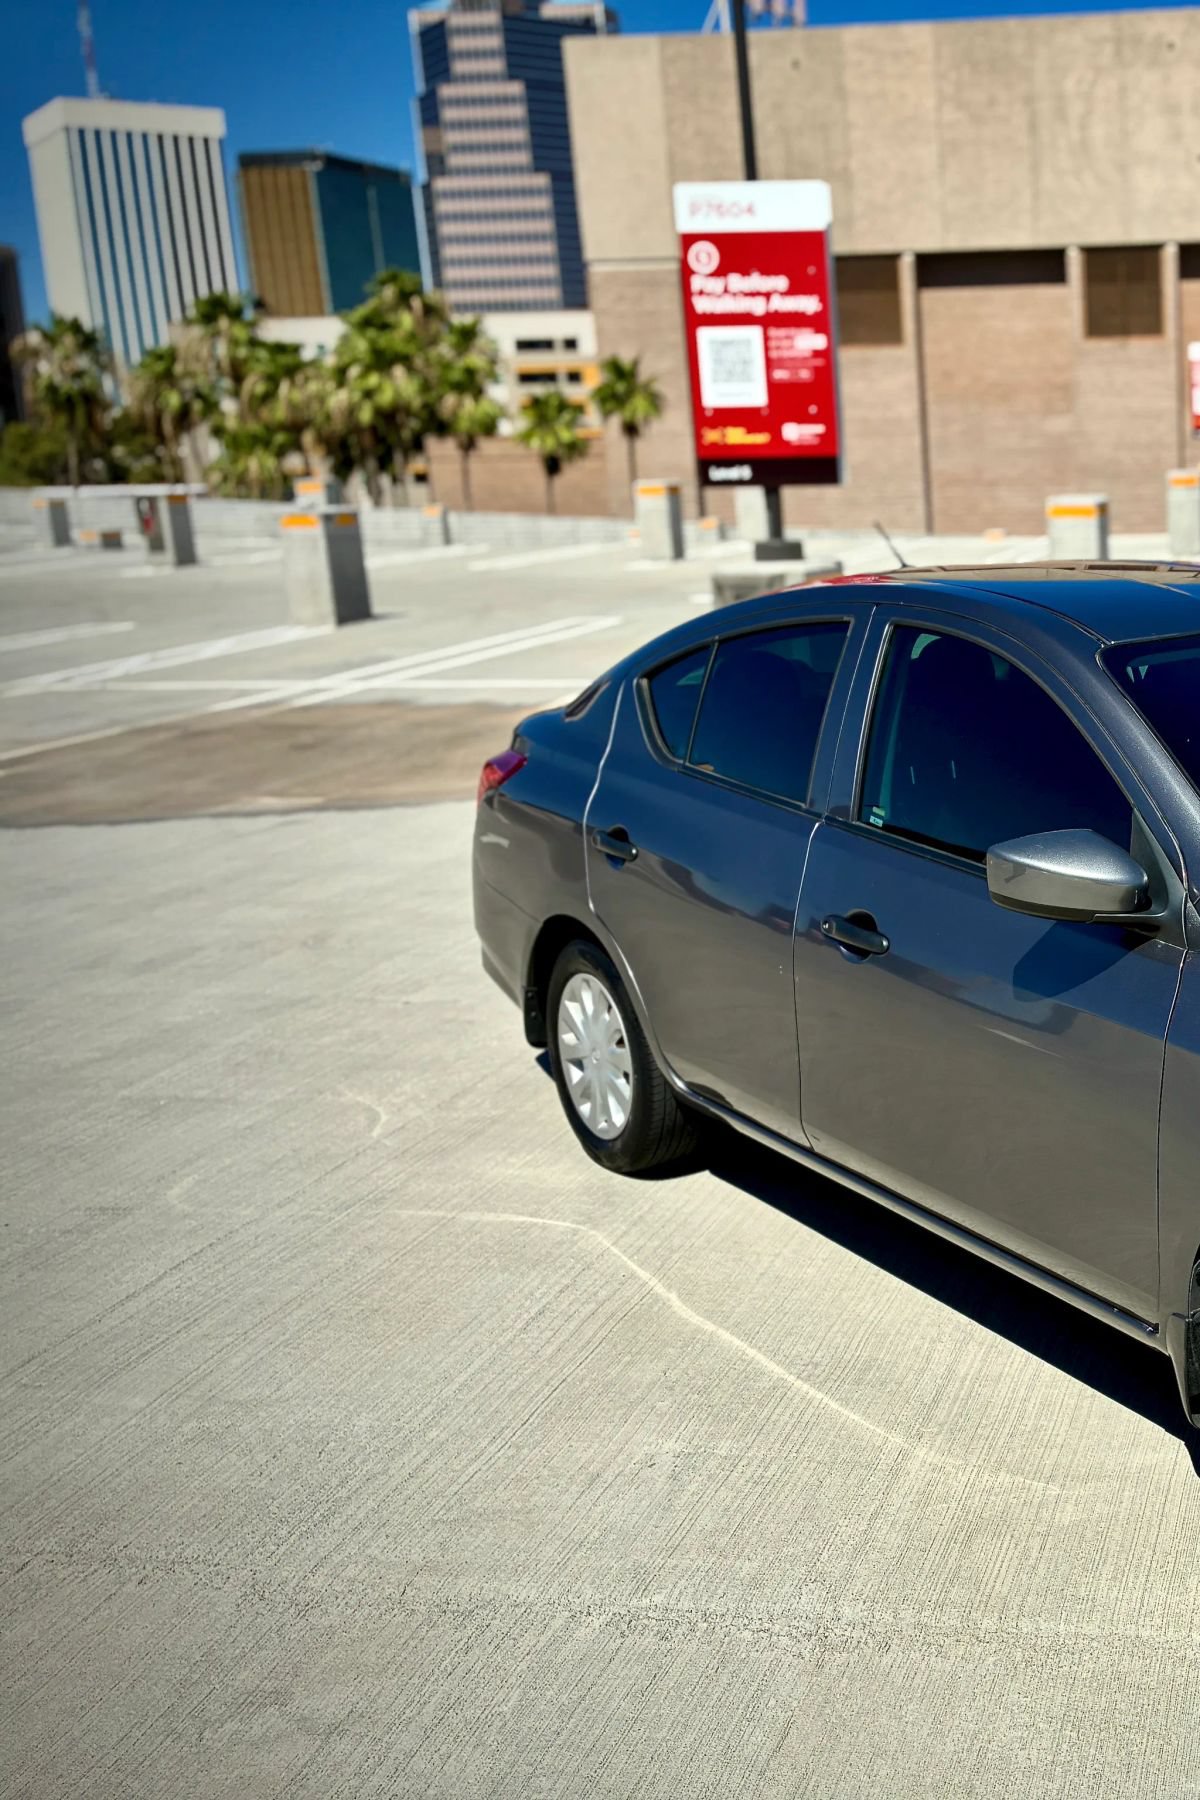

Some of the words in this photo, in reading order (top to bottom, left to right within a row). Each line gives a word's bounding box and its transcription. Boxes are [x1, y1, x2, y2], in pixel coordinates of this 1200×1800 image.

[690, 274, 725, 295] Pay
[728, 272, 788, 292] Before
[692, 294, 766, 315] Walking
[768, 293, 822, 314] Away.
[709, 466, 740, 480] Level
